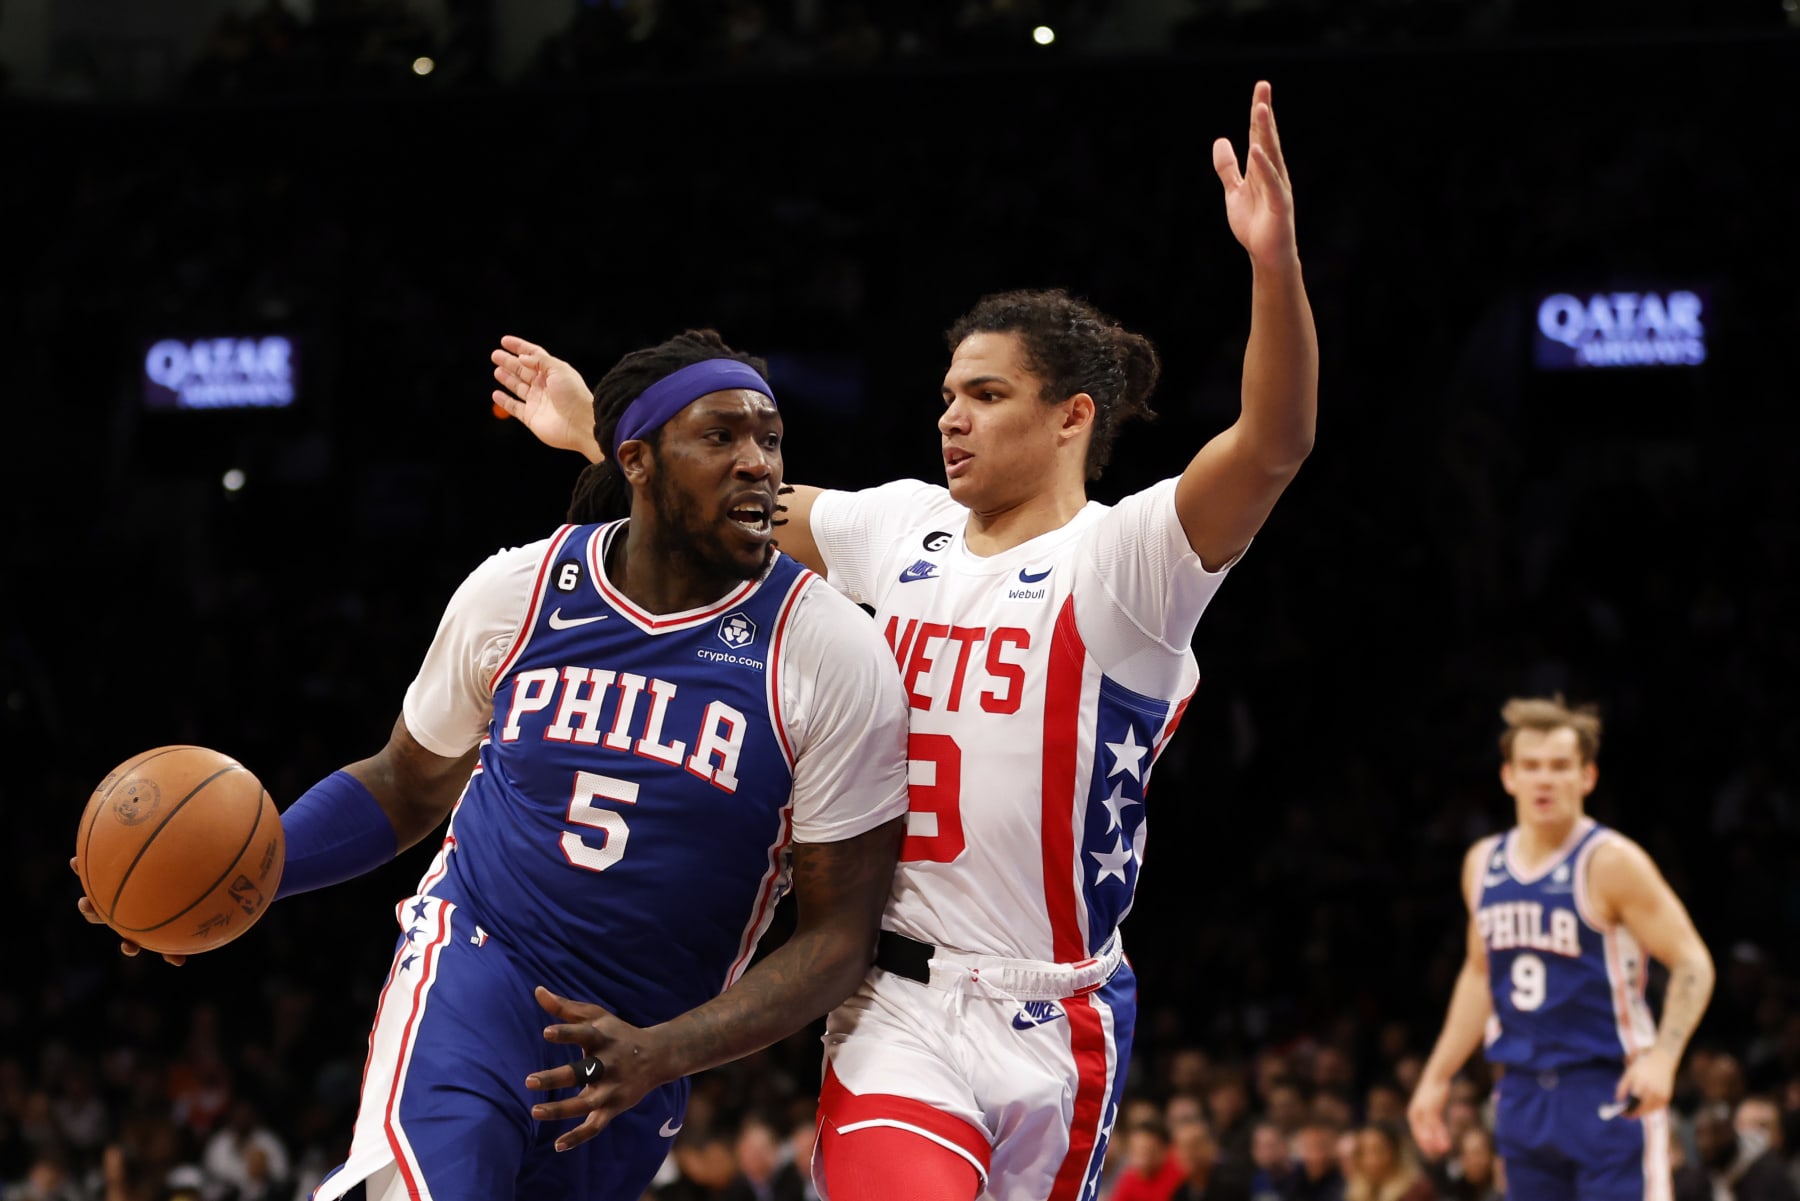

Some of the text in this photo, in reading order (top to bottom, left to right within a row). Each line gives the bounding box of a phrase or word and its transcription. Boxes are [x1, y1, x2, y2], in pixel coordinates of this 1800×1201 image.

[1538, 291, 1703, 348] QATAR
[146, 337, 292, 391] QATAR
[557, 563, 579, 591] 6
[1008, 589, 1045, 600] Webull
[697, 649, 764, 670] crypto.com
[501, 665, 747, 794] PHILA
[559, 770, 640, 872] 5
[1477, 902, 1581, 958] PHILA
[1024, 1001, 1055, 1019] NIKE
[1511, 954, 1546, 1011] 9
